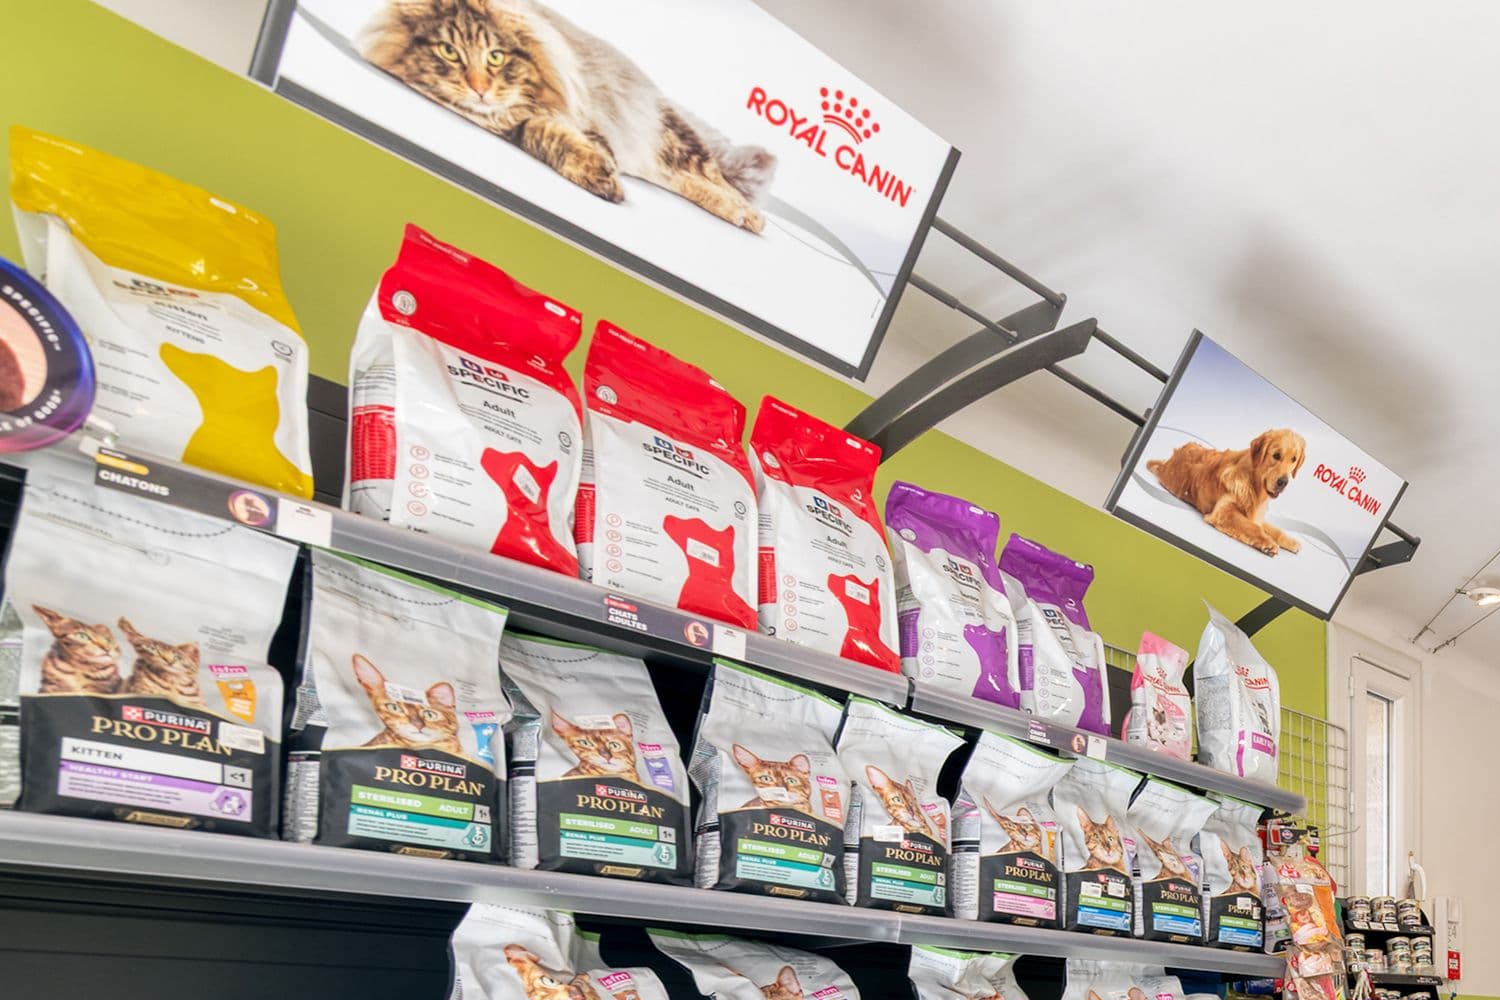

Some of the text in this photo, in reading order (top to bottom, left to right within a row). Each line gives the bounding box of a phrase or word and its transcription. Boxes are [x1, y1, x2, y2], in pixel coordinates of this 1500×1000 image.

[747, 87, 912, 207] ROYAL CANIN
[447, 364, 530, 399] SPECIFIC
[483, 400, 515, 418] Adult
[642, 442, 710, 476] SPECIFIC
[98, 469, 170, 497] CHATONS
[666, 474, 695, 492] Adult
[1313, 463, 1381, 516] ROYAL CANIN
[806, 504, 853, 534] SPECIFIC
[608, 607, 638, 621] CHATS
[608, 613, 648, 633] ADULTES
[91, 716, 157, 742] PRO
[144, 711, 208, 730] PURINA
[71, 746, 123, 761] KITTEN
[69, 763, 154, 783] HEALTHY START
[418, 760, 463, 775] PURINA
[230, 771, 246, 785] <1
[375, 766, 483, 797] PRO PLAN
[358, 791, 469, 816] STERILISED ADULT
[607, 788, 645, 801] PURINA
[576, 794, 663, 819] PRO PLAN
[565, 818, 616, 831] STERILISED
[629, 826, 654, 836] ADULT
[781, 816, 814, 830] PURINA
[752, 823, 829, 847] PRO PLAN
[741, 842, 787, 856] STERILISED
[909, 841, 932, 851] PURINA
[885, 847, 942, 866] PRO PLAN
[1005, 865, 1053, 882] PRO PLAN
[1160, 890, 1180, 901] PRO
[602, 972, 632, 987] isfm
